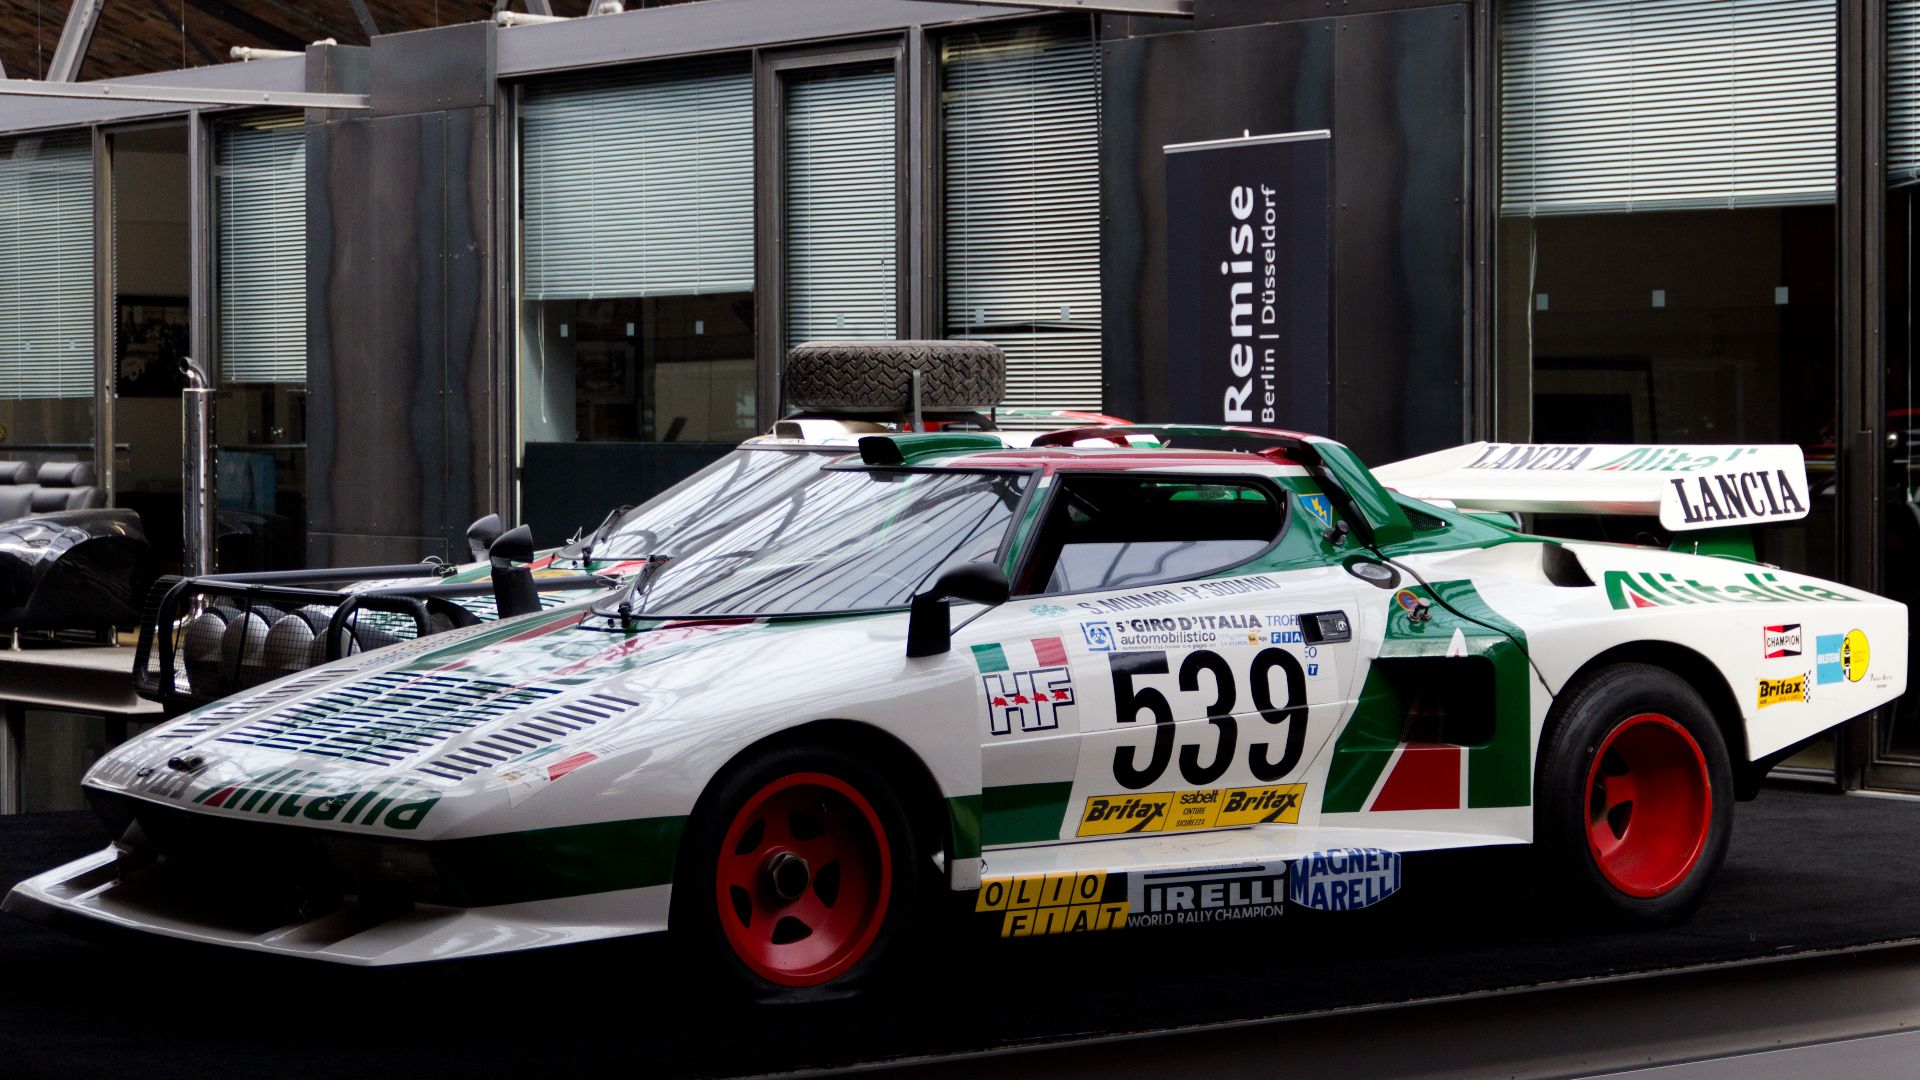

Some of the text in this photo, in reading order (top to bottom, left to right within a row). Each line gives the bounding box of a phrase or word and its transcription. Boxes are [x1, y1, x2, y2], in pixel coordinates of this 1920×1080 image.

[1261, 184, 1276, 324] Düsseldorf
[1221, 186, 1253, 422] Remise
[1261, 349, 1275, 423] Berlin
[1463, 446, 1593, 470] LANCIA
[1671, 469, 1805, 523] LANCIA
[1604, 570, 1863, 610] Alitalia
[1121, 632, 1216, 645] automobilistico
[1131, 618, 1177, 633] GIRO
[1766, 635, 1800, 648] CHAMPION
[982, 667, 1075, 736] HF
[1759, 680, 1802, 698] Britax
[1107, 647, 1309, 790] 539
[190, 767, 442, 830] Alitalia
[1180, 789, 1219, 804] sabelt
[1223, 790, 1299, 823] Britax
[1085, 799, 1167, 832] Britax
[1291, 848, 1400, 881] MAGNETI
[985, 875, 1098, 907] OLIO
[1127, 860, 1287, 913] PIRELLI
[1291, 874, 1400, 911] MARELLI
[1010, 907, 1122, 937] FIAT
[1128, 905, 1284, 928] WORLD RALLY CHAMPION
